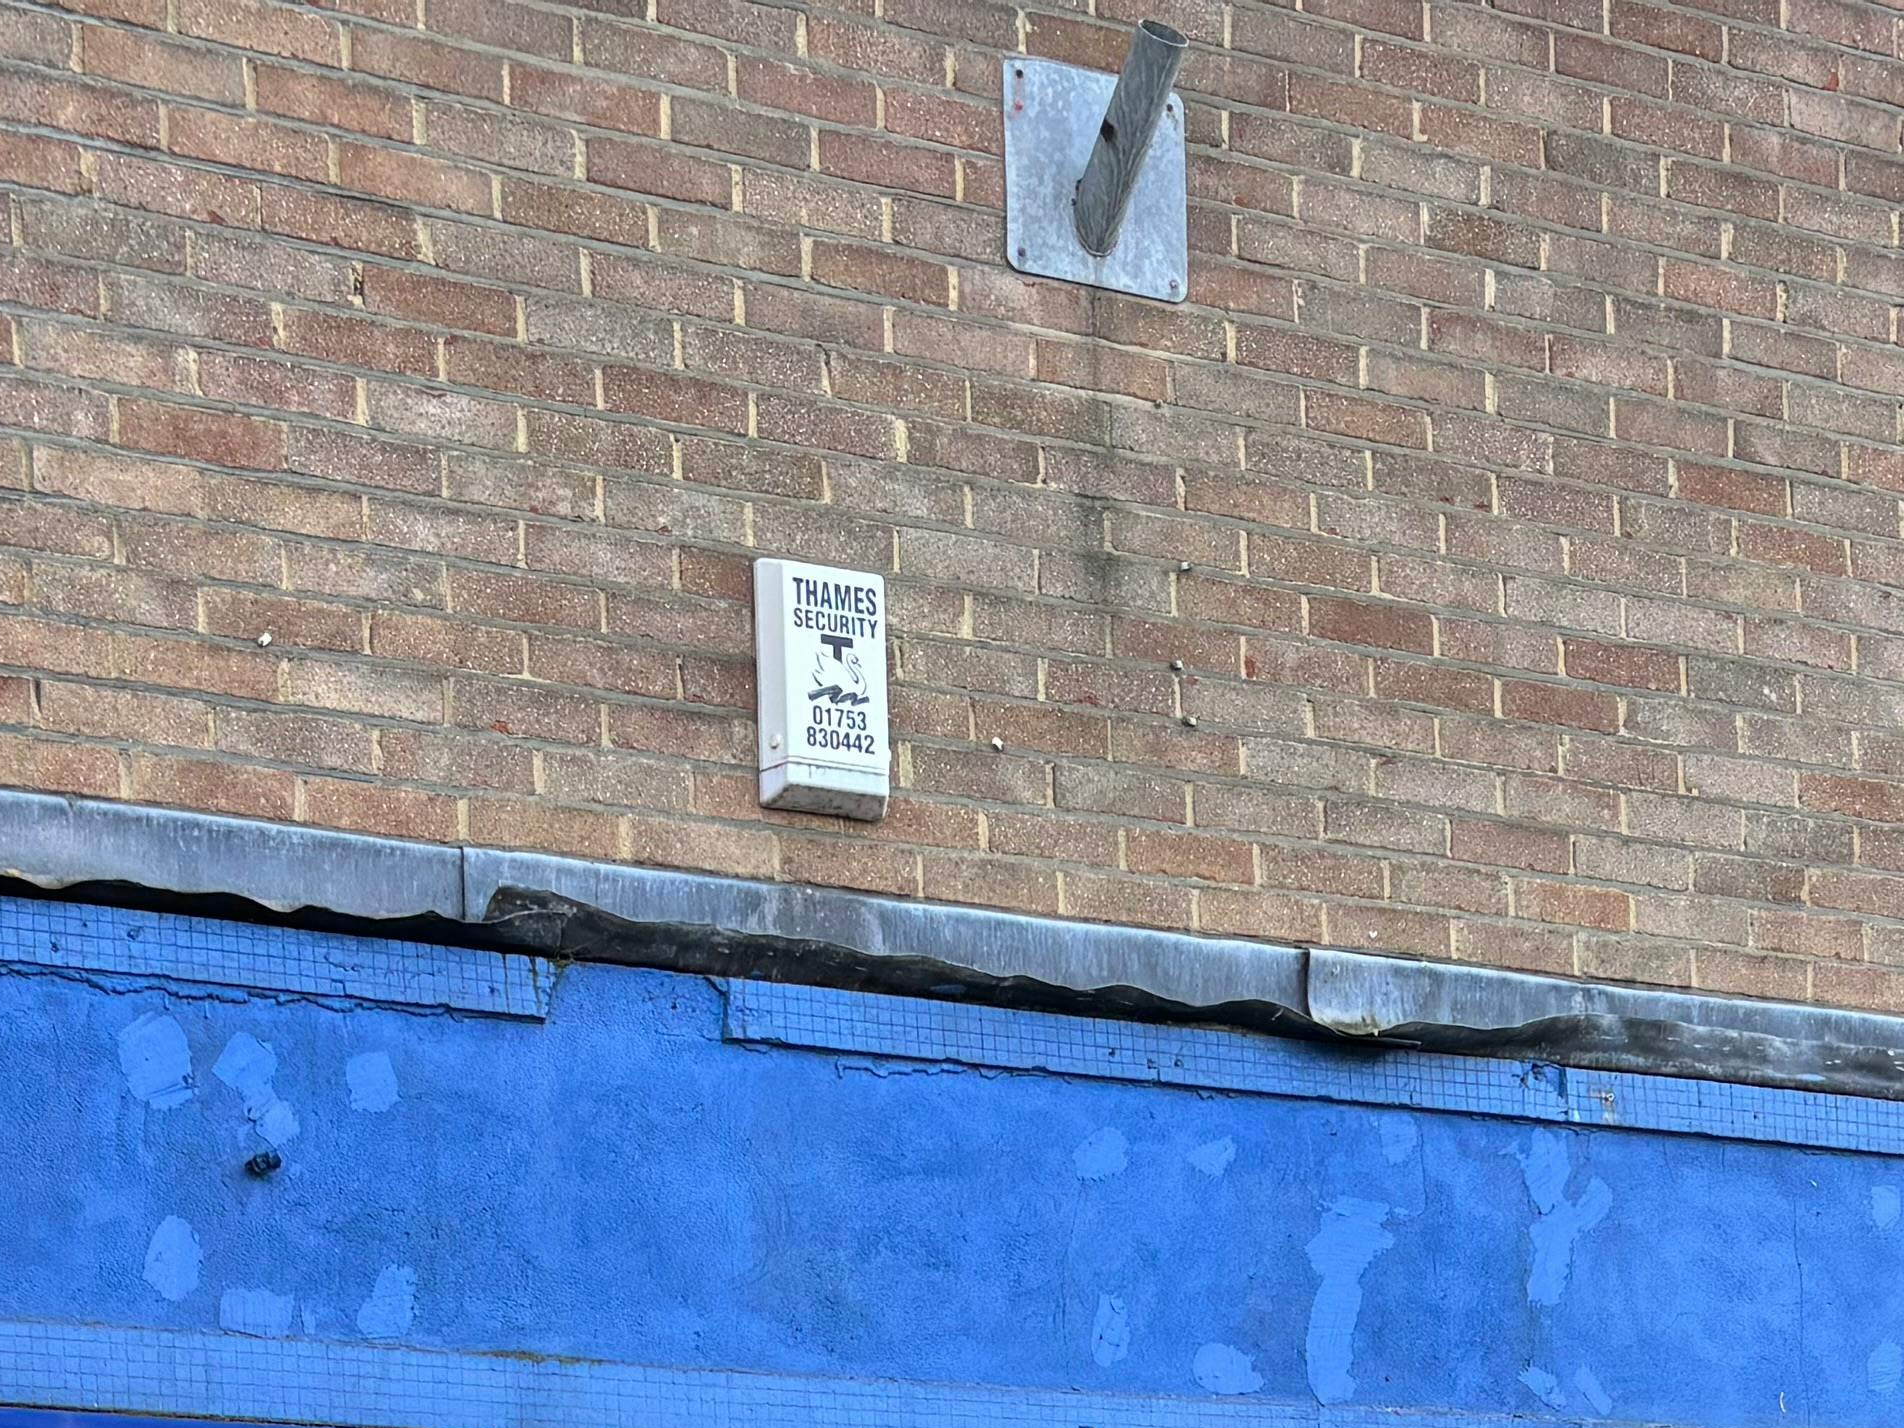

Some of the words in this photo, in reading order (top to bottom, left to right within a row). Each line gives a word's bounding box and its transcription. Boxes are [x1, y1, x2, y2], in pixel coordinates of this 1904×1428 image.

[792, 576, 877, 617] THAMES
[793, 607, 878, 639] SECURITY
[812, 705, 867, 731] 01753
[806, 726, 876, 755] 830442
